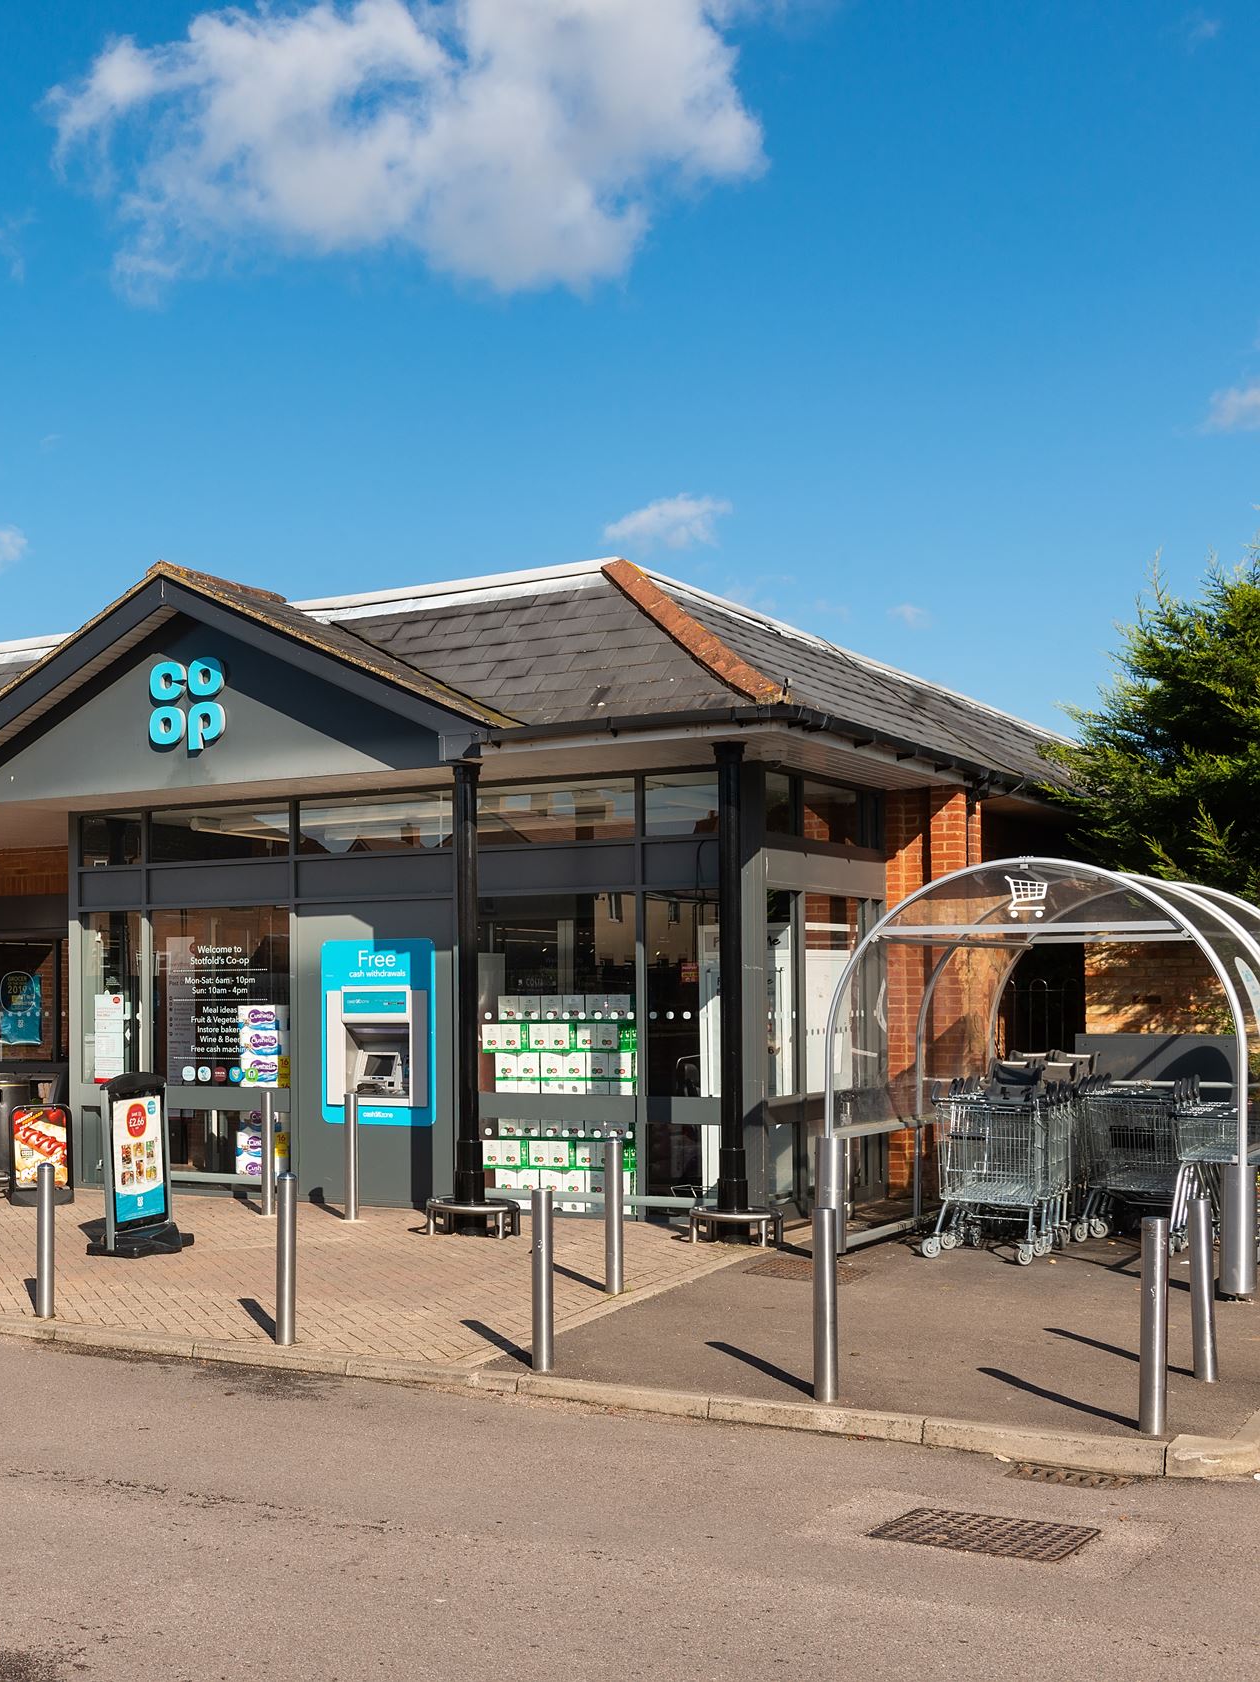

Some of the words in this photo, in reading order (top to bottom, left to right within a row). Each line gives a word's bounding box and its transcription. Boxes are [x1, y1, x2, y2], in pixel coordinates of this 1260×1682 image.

[197, 945, 232, 954] Welcome
[234, 945, 242, 953] to
[190, 956, 225, 965] Stotfold's
[225, 956, 250, 966] Co-op
[358, 949, 396, 967] Free
[348, 970, 365, 978] cash
[365, 969, 406, 978] withdrawals
[184, 976, 214, 984] Mon-Sat:
[215, 976, 230, 984] 6am
[235, 976, 256, 985] 10pm
[7, 985, 27, 994] 2019
[232, 987, 248, 996] 4pm
[212, 1016, 243, 1025] Vegetab
[129, 1117, 145, 1127] £2.66
